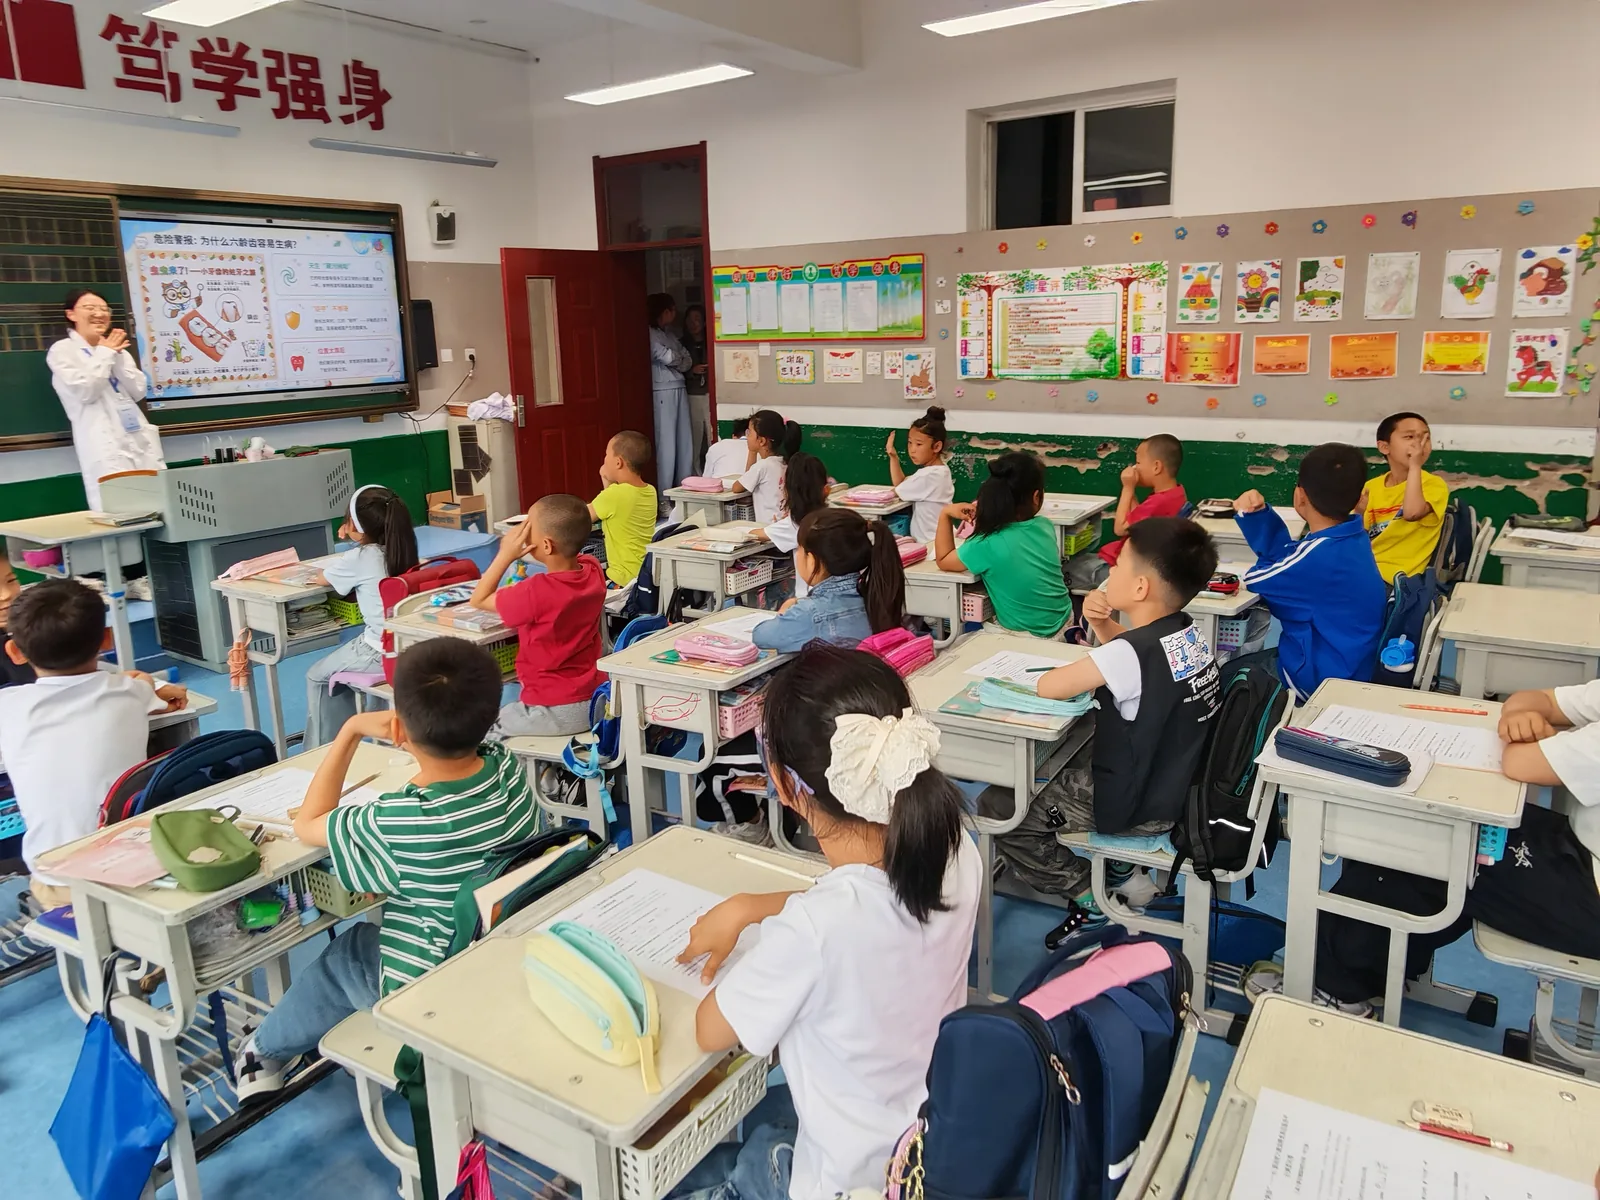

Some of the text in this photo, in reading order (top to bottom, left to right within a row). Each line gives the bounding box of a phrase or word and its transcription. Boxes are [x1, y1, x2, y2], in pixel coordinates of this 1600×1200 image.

[99, 13, 393, 131] 笃学强身
[153, 233, 298, 250] 危险警报：为什么六龄齿容易生病？
[1023, 278, 1088, 293] 明星评比栏
